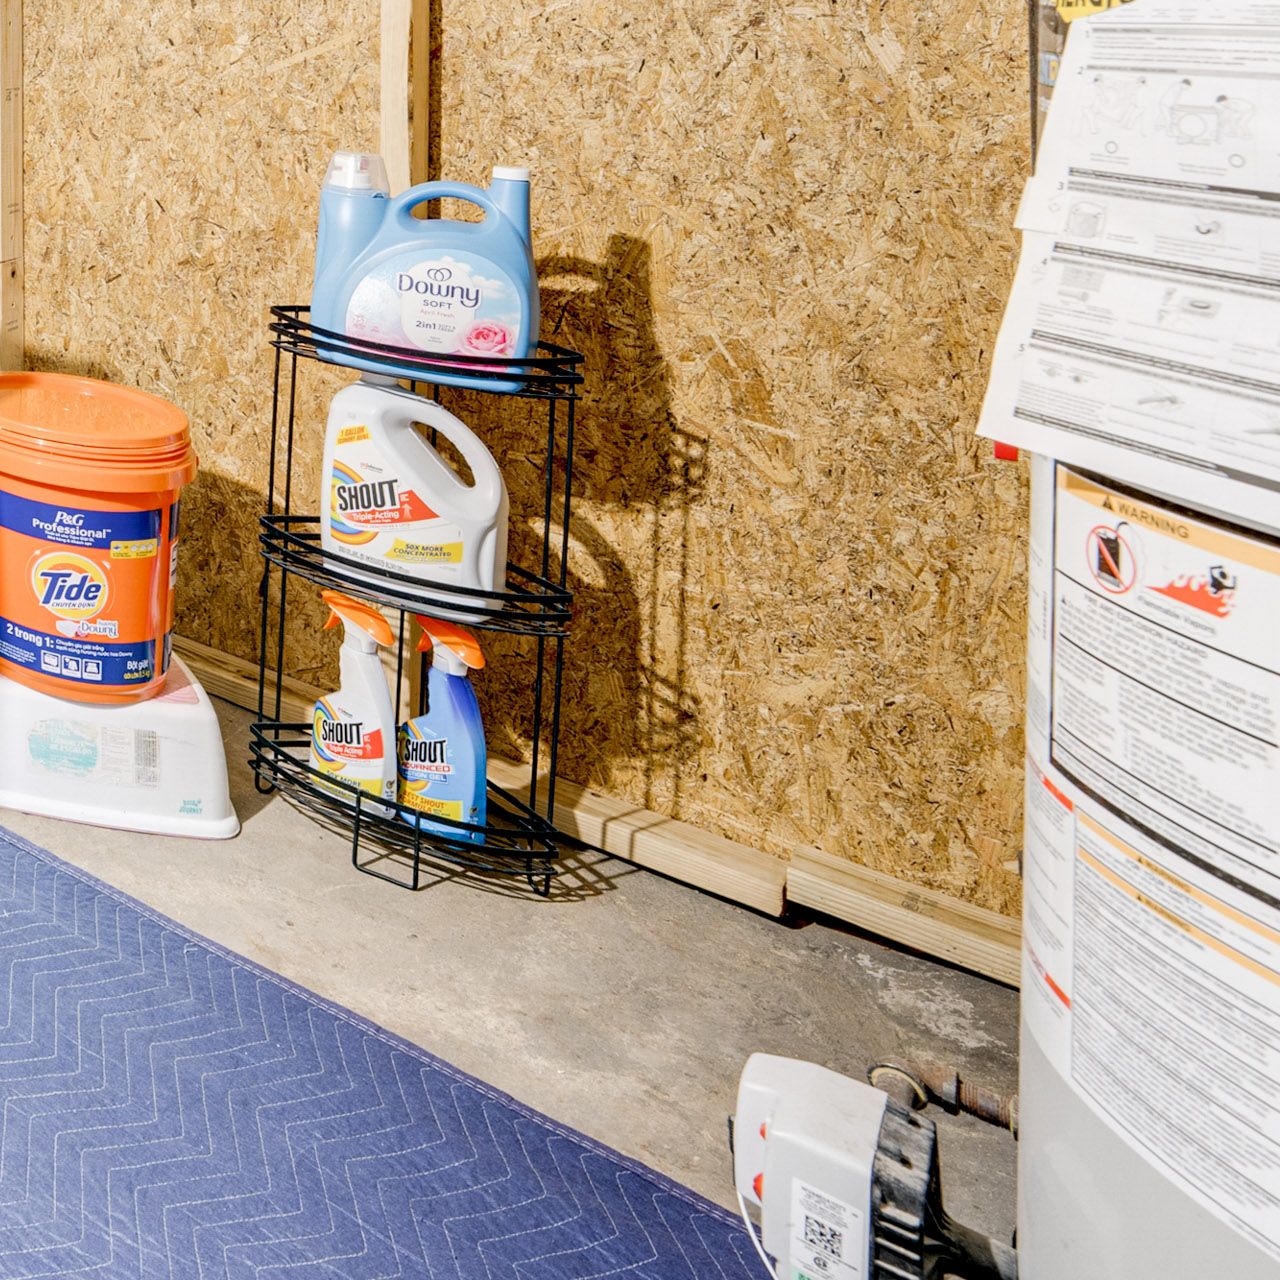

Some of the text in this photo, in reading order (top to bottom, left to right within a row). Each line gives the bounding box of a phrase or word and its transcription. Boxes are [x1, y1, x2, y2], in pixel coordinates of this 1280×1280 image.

[398, 273, 480, 309] Downy
[422, 299, 453, 310] SOFT
[415, 320, 437, 330] 2in1
[337, 479, 399, 512] SHOUT
[54, 510, 85, 526] P&G
[351, 511, 400, 522] Triple-Acting
[1118, 501, 1190, 539] WARNING
[393, 547, 452, 558] CONCENTRATED
[405, 543, 444, 552] 50X MORE
[40, 571, 102, 605] Tide
[6, 623, 55, 649] 2 trong 1:
[81, 622, 118, 638] Downy
[321, 719, 363, 745] SHOUT
[404, 738, 446, 764] SHOUT
[420, 795, 445, 809] SHOUT
